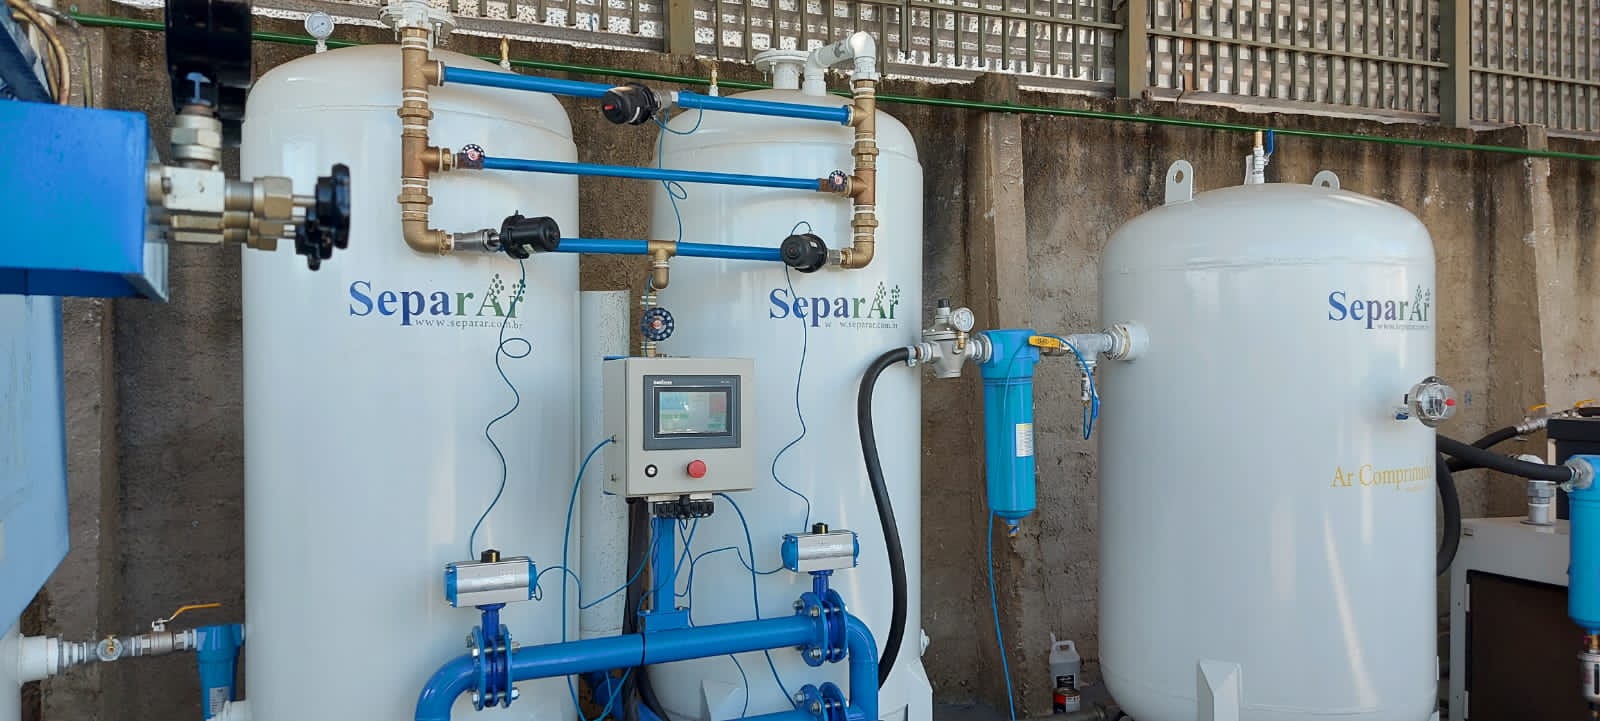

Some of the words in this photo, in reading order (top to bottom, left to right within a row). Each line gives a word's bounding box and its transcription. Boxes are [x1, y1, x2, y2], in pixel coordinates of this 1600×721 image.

[769, 284, 900, 327] SeparAr
[1328, 287, 1430, 329] SeparAr
[1331, 465, 1354, 488] Ar
